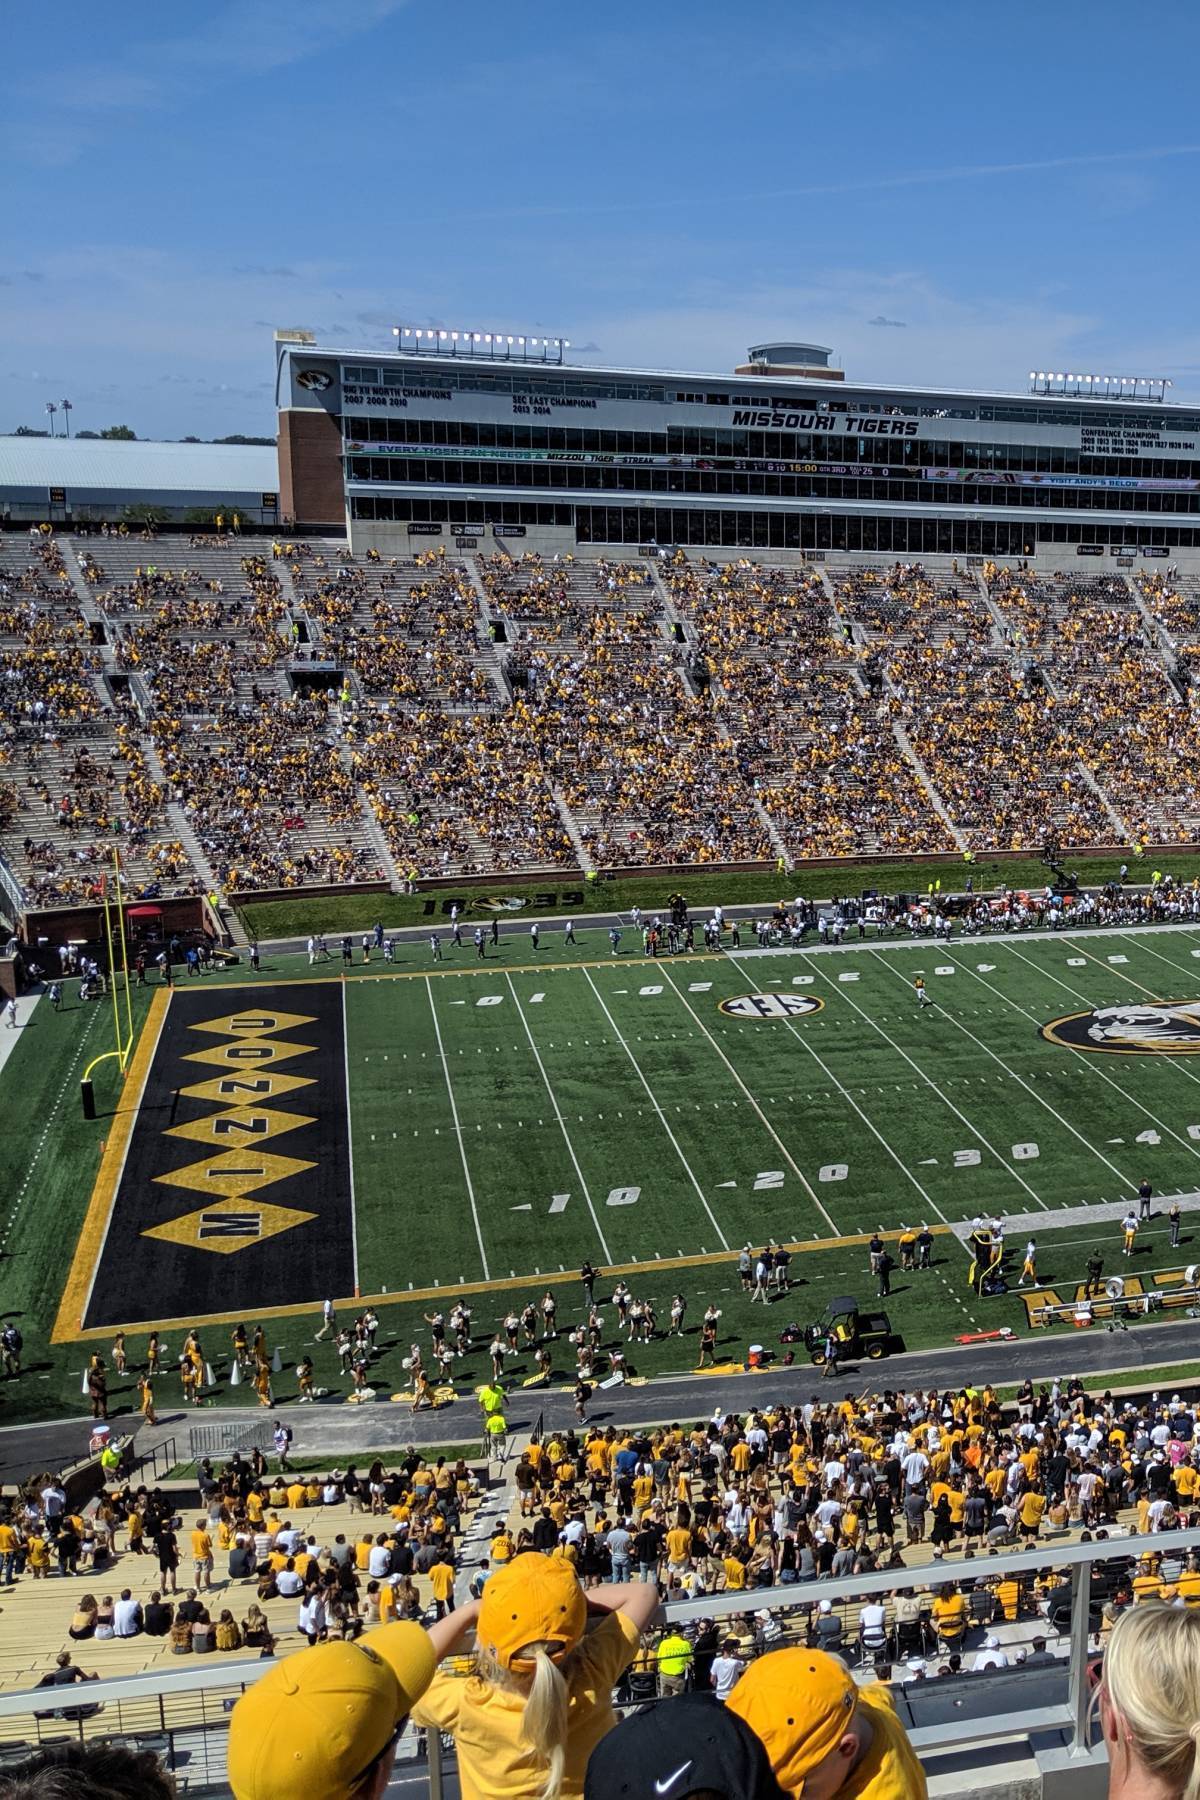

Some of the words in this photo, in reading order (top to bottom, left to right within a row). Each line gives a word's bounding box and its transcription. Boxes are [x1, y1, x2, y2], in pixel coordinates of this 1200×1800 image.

[343, 384, 357, 394] BIG
[372, 386, 400, 397] NORTH
[402, 388, 452, 400] CHAMPIONS
[512, 395, 527, 404] SEC
[529, 396, 549, 406] EAST
[550, 397, 597, 409] CHAMPIONS
[512, 405, 530, 414] 2013
[533, 406, 551, 415] 2014
[732, 410, 836, 431] MISSOURI
[845, 417, 920, 436] TIGERS
[1081, 428, 1121, 438] CONFERENCE
[1122, 431, 1160, 440] CHAMPIONS
[378, 445, 419, 453] EVERY
[547, 452, 585, 462] MIZZOU
[591, 455, 615, 463] TIGER
[622, 456, 654, 465] STREAK
[789, 464, 817, 473] 15:00
[862, 467, 873, 475] 25
[882, 467, 889, 476] 0
[726, 993, 819, 1018] SEC
[198, 1017, 278, 1241] MIZZOU
